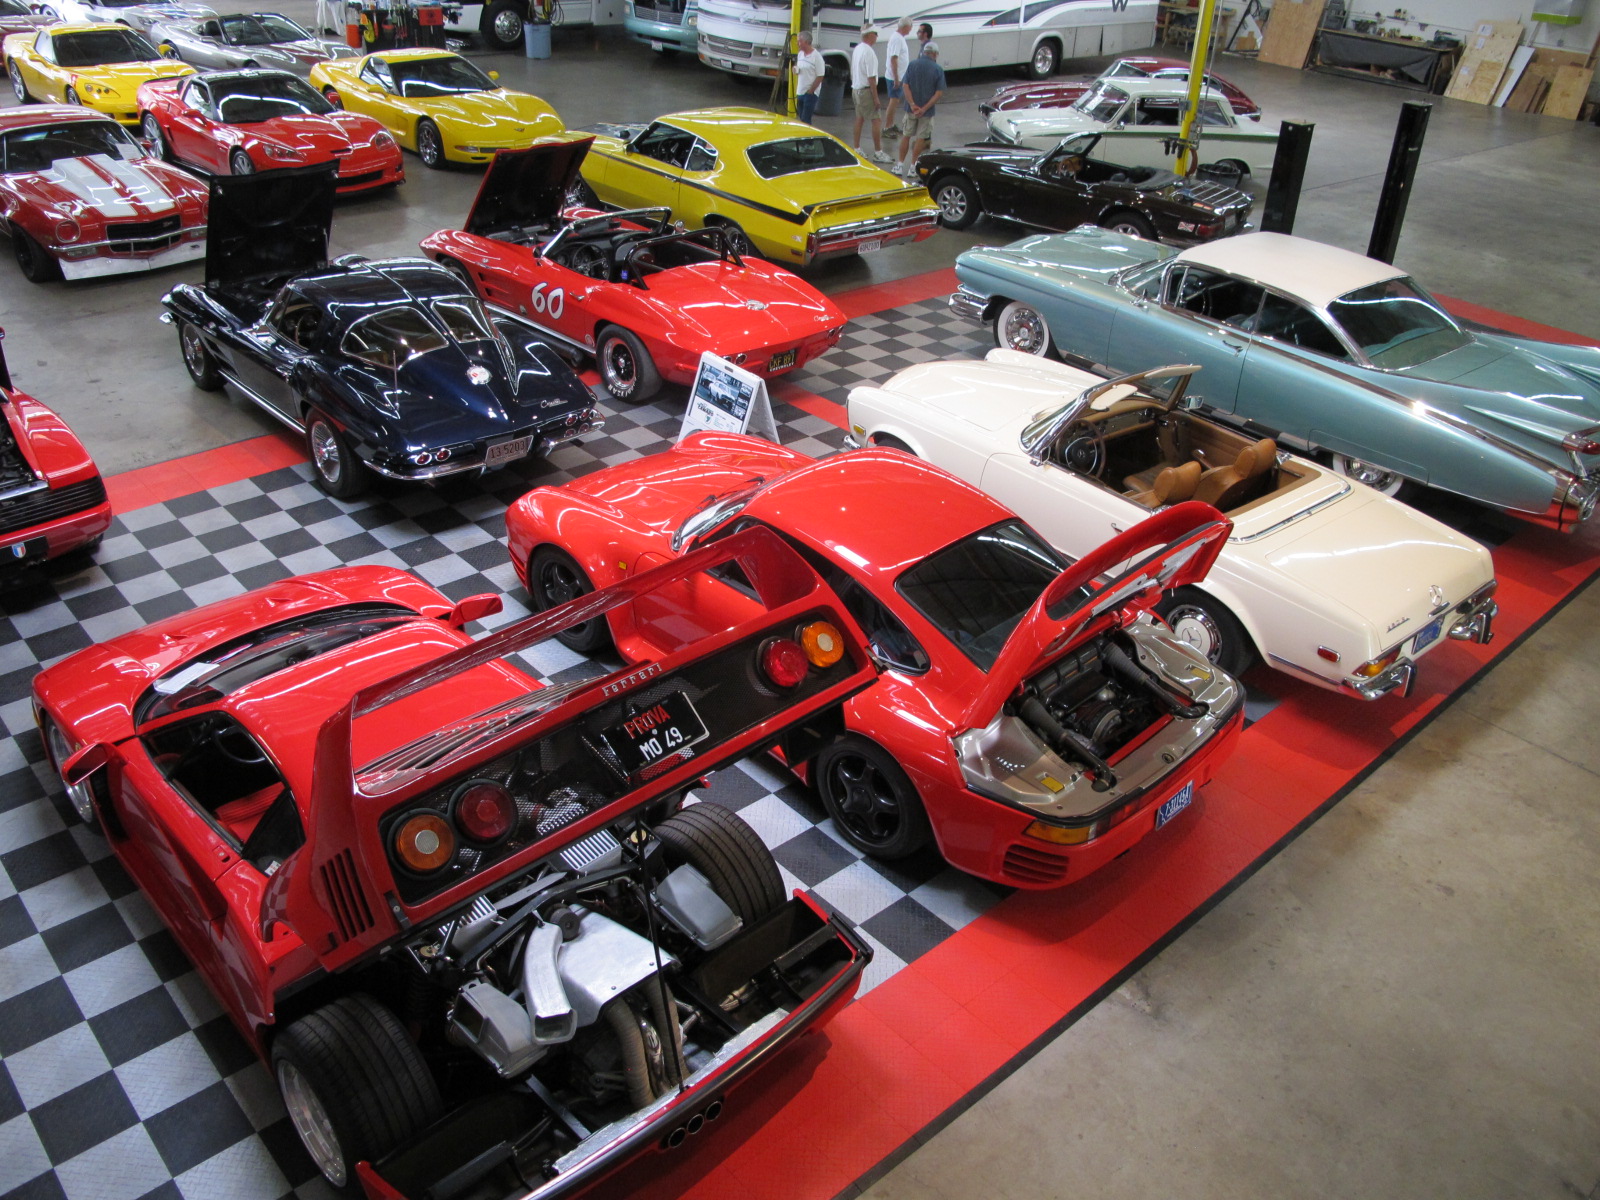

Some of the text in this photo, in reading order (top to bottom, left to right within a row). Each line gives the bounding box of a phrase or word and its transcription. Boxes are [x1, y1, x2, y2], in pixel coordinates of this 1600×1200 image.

[531, 281, 564, 320] 60
[601, 662, 663, 697] Ferrari
[623, 704, 671, 740] PROVA
[638, 726, 684, 762] MO 49
